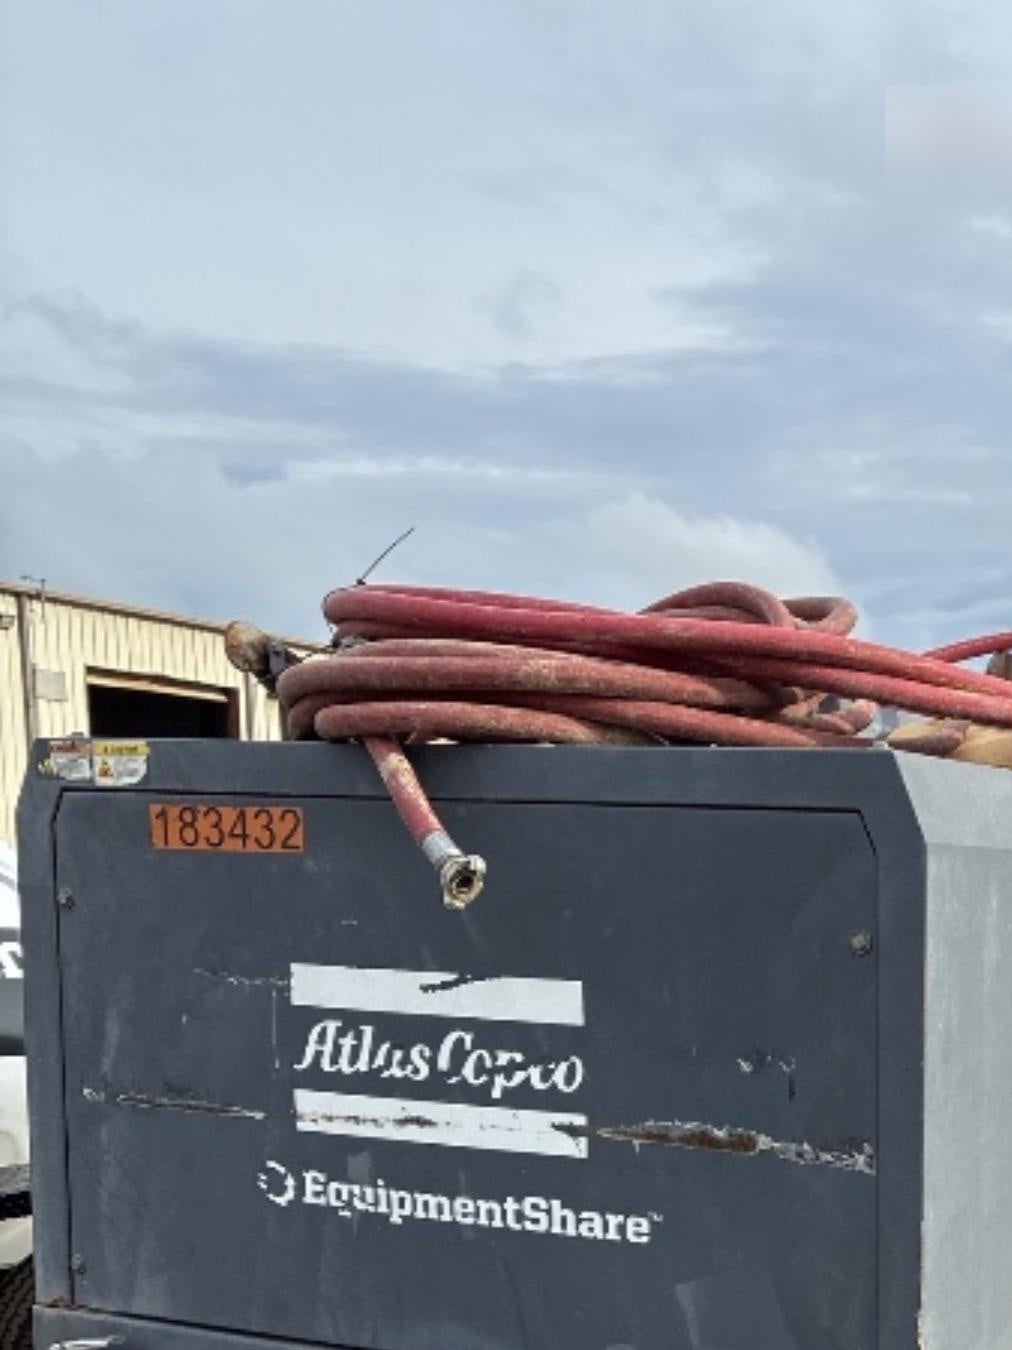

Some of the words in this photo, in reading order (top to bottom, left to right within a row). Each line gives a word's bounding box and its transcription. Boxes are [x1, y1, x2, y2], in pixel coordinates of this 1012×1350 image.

[154, 806, 301, 850] 183432
[294, 1019, 432, 1081] Atlas
[436, 1030, 584, 1098] Copco
